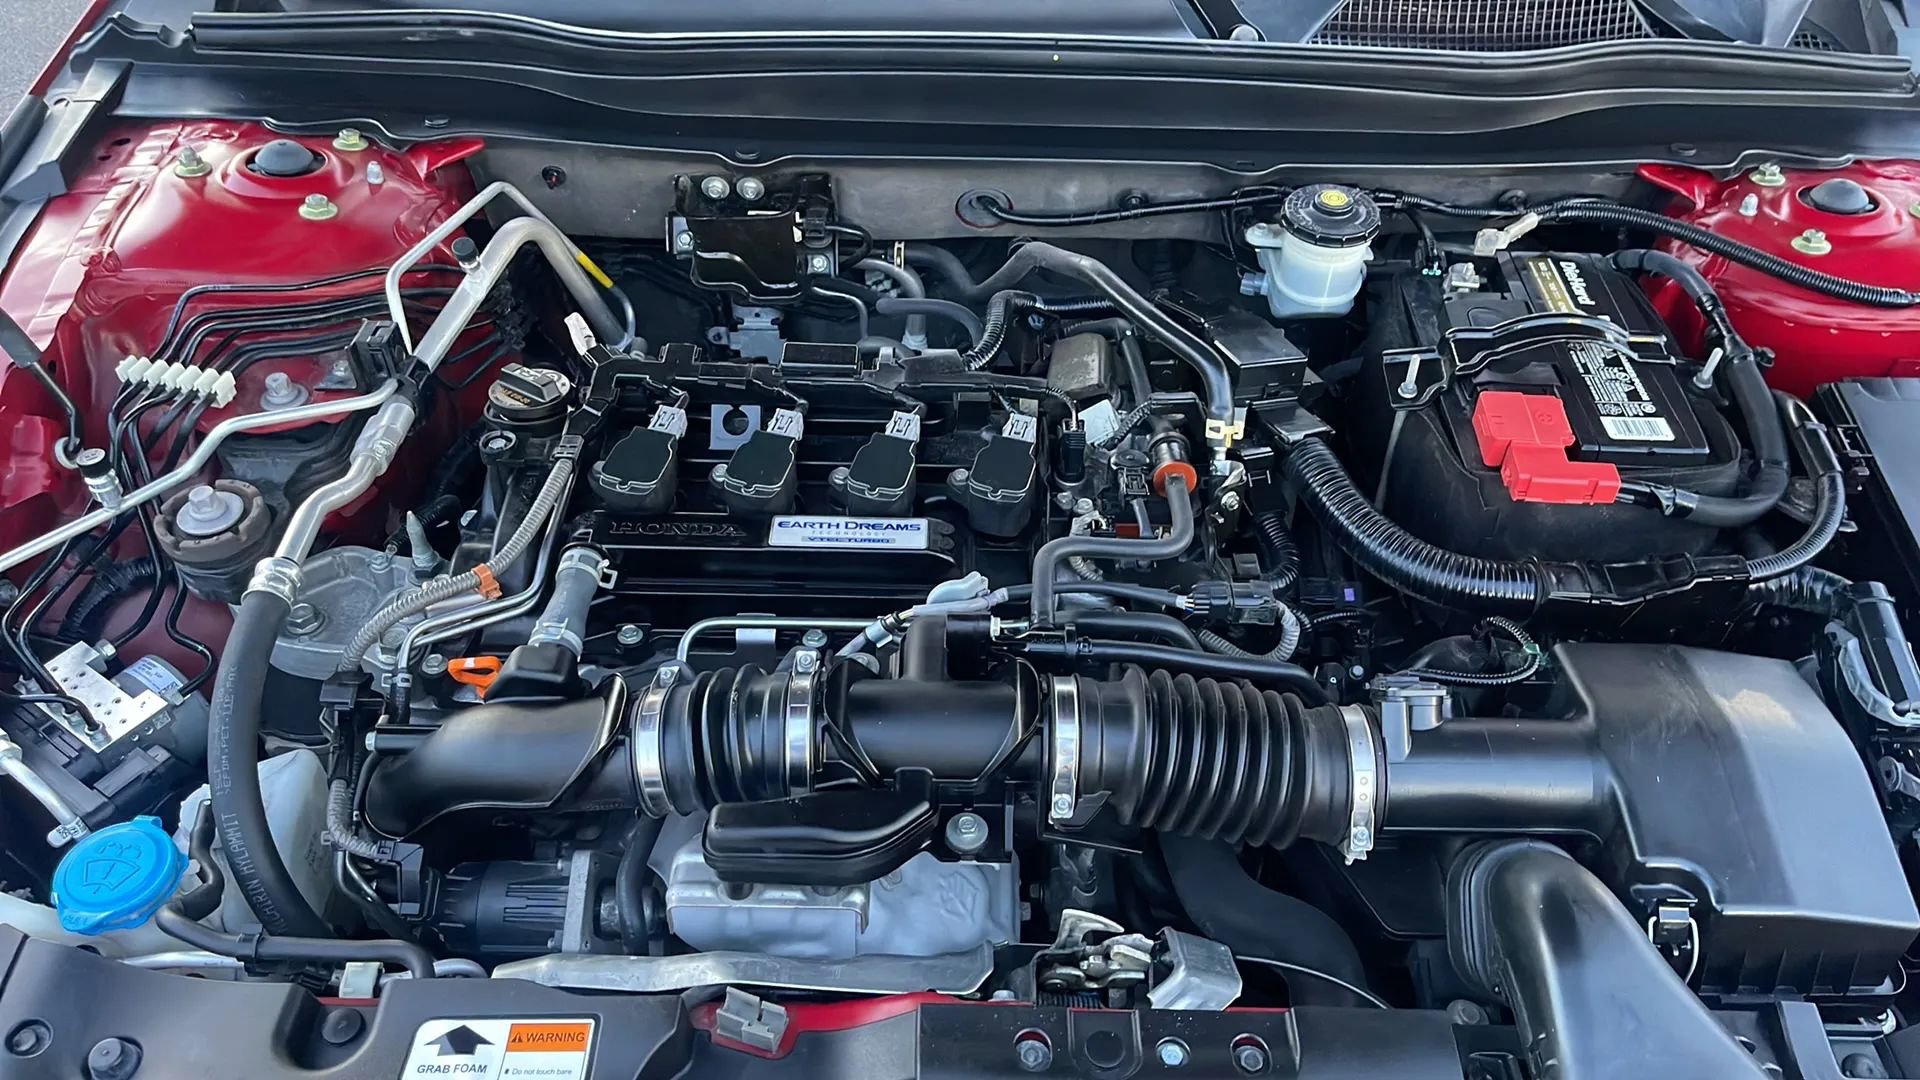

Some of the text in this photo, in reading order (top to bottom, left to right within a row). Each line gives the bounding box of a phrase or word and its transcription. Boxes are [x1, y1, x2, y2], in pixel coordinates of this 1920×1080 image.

[1559, 261, 1596, 306] DieHard
[609, 521, 748, 537] HONDA
[777, 521, 921, 531] EARTH DREAMS
[526, 1031, 586, 1044] WARNING
[416, 1063, 488, 1074] GRAB FOAM
[511, 1067, 573, 1076] Do not touch bare
